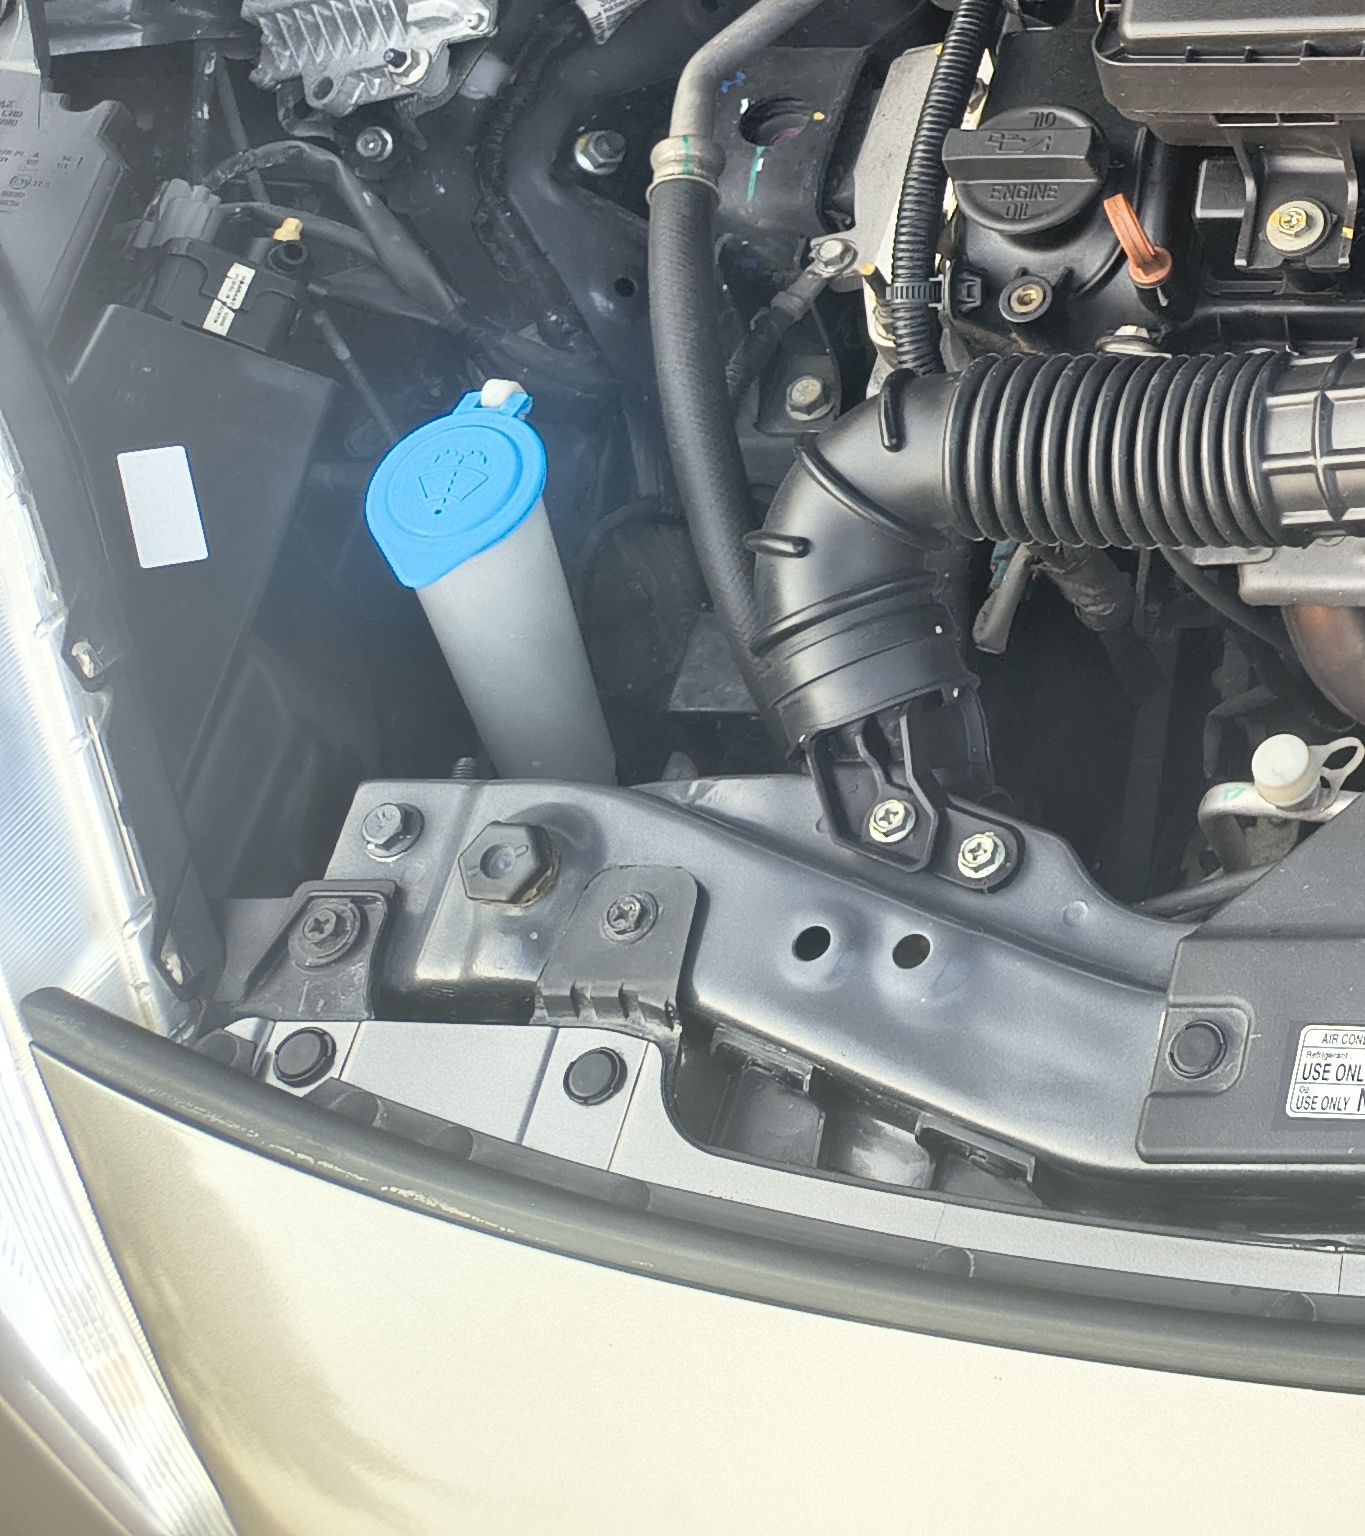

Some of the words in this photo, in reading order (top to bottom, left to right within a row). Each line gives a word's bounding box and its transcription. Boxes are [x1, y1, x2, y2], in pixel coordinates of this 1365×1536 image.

[988, 184, 1060, 202] ENGINE
[1003, 203, 1030, 219] OIL
[1321, 1033, 1338, 1044] AIR
[1302, 1063, 1332, 1081] USE
[1295, 1095, 1319, 1110] USE
[1320, 1096, 1351, 1111] ONLY
